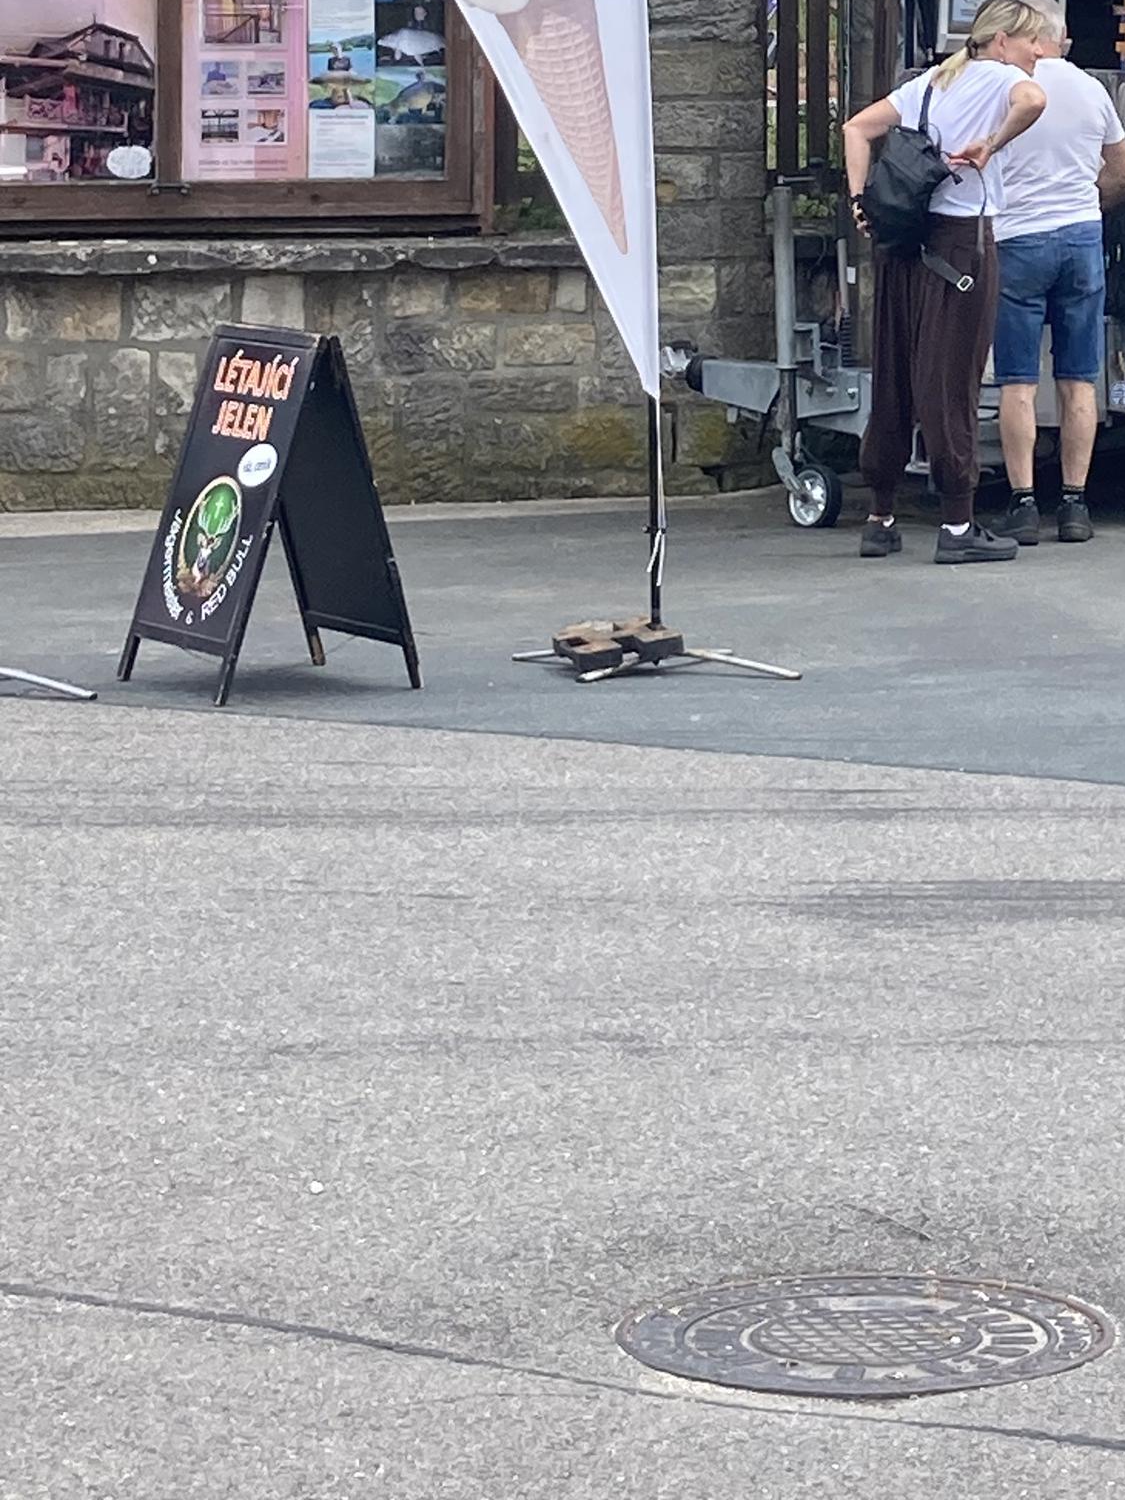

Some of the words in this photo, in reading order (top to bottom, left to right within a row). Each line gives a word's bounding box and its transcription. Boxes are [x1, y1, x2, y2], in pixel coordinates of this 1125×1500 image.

[213, 349, 300, 401] LÉTAJÍCÍ
[211, 400, 274, 442] JELEN
[201, 583, 228, 621] RED
[225, 534, 254, 586] BULL
